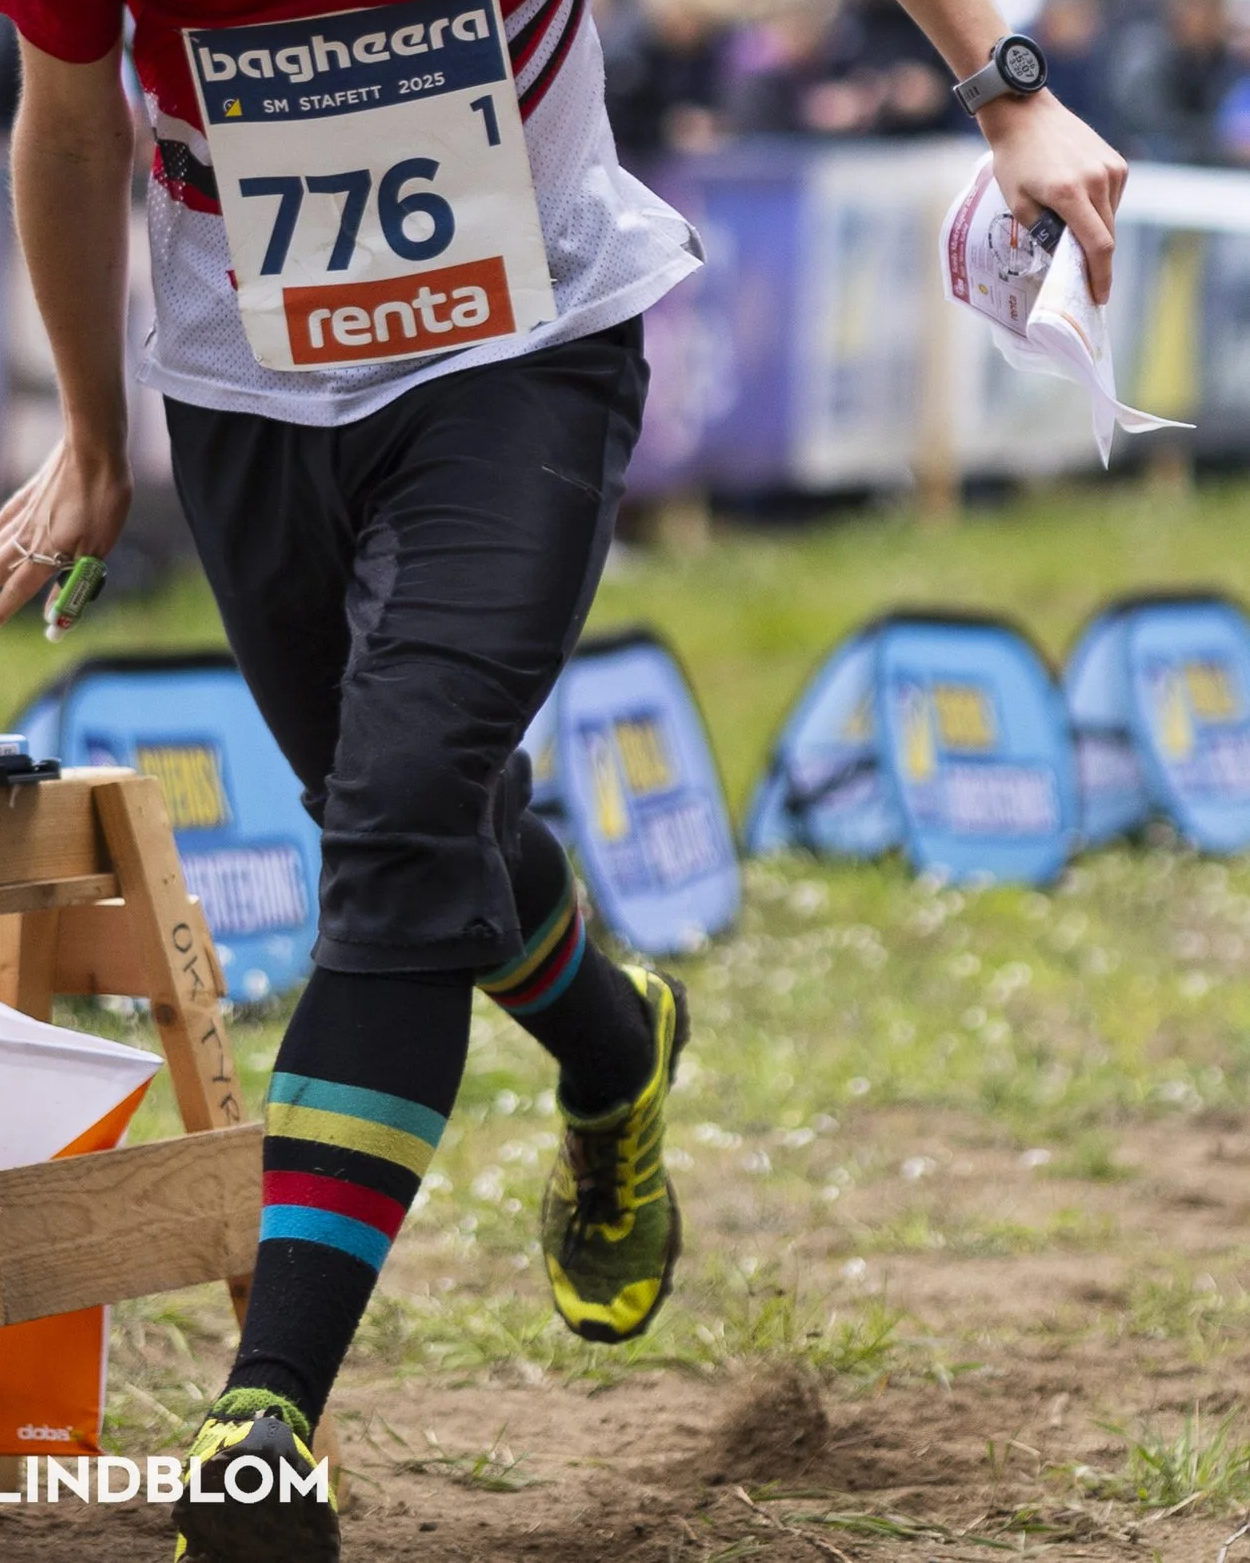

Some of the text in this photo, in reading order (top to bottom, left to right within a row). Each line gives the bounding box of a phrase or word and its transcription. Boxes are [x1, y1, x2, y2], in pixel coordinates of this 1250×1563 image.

[198, 8, 490, 84] bagheera
[1012, 49, 1035, 77] 45:07
[263, 72, 447, 114] SM STAFETT 2025
[469, 94, 502, 147] 1
[238, 156, 456, 276] 776
[307, 285, 491, 349] renta
[171, 921, 205, 1003] OK
